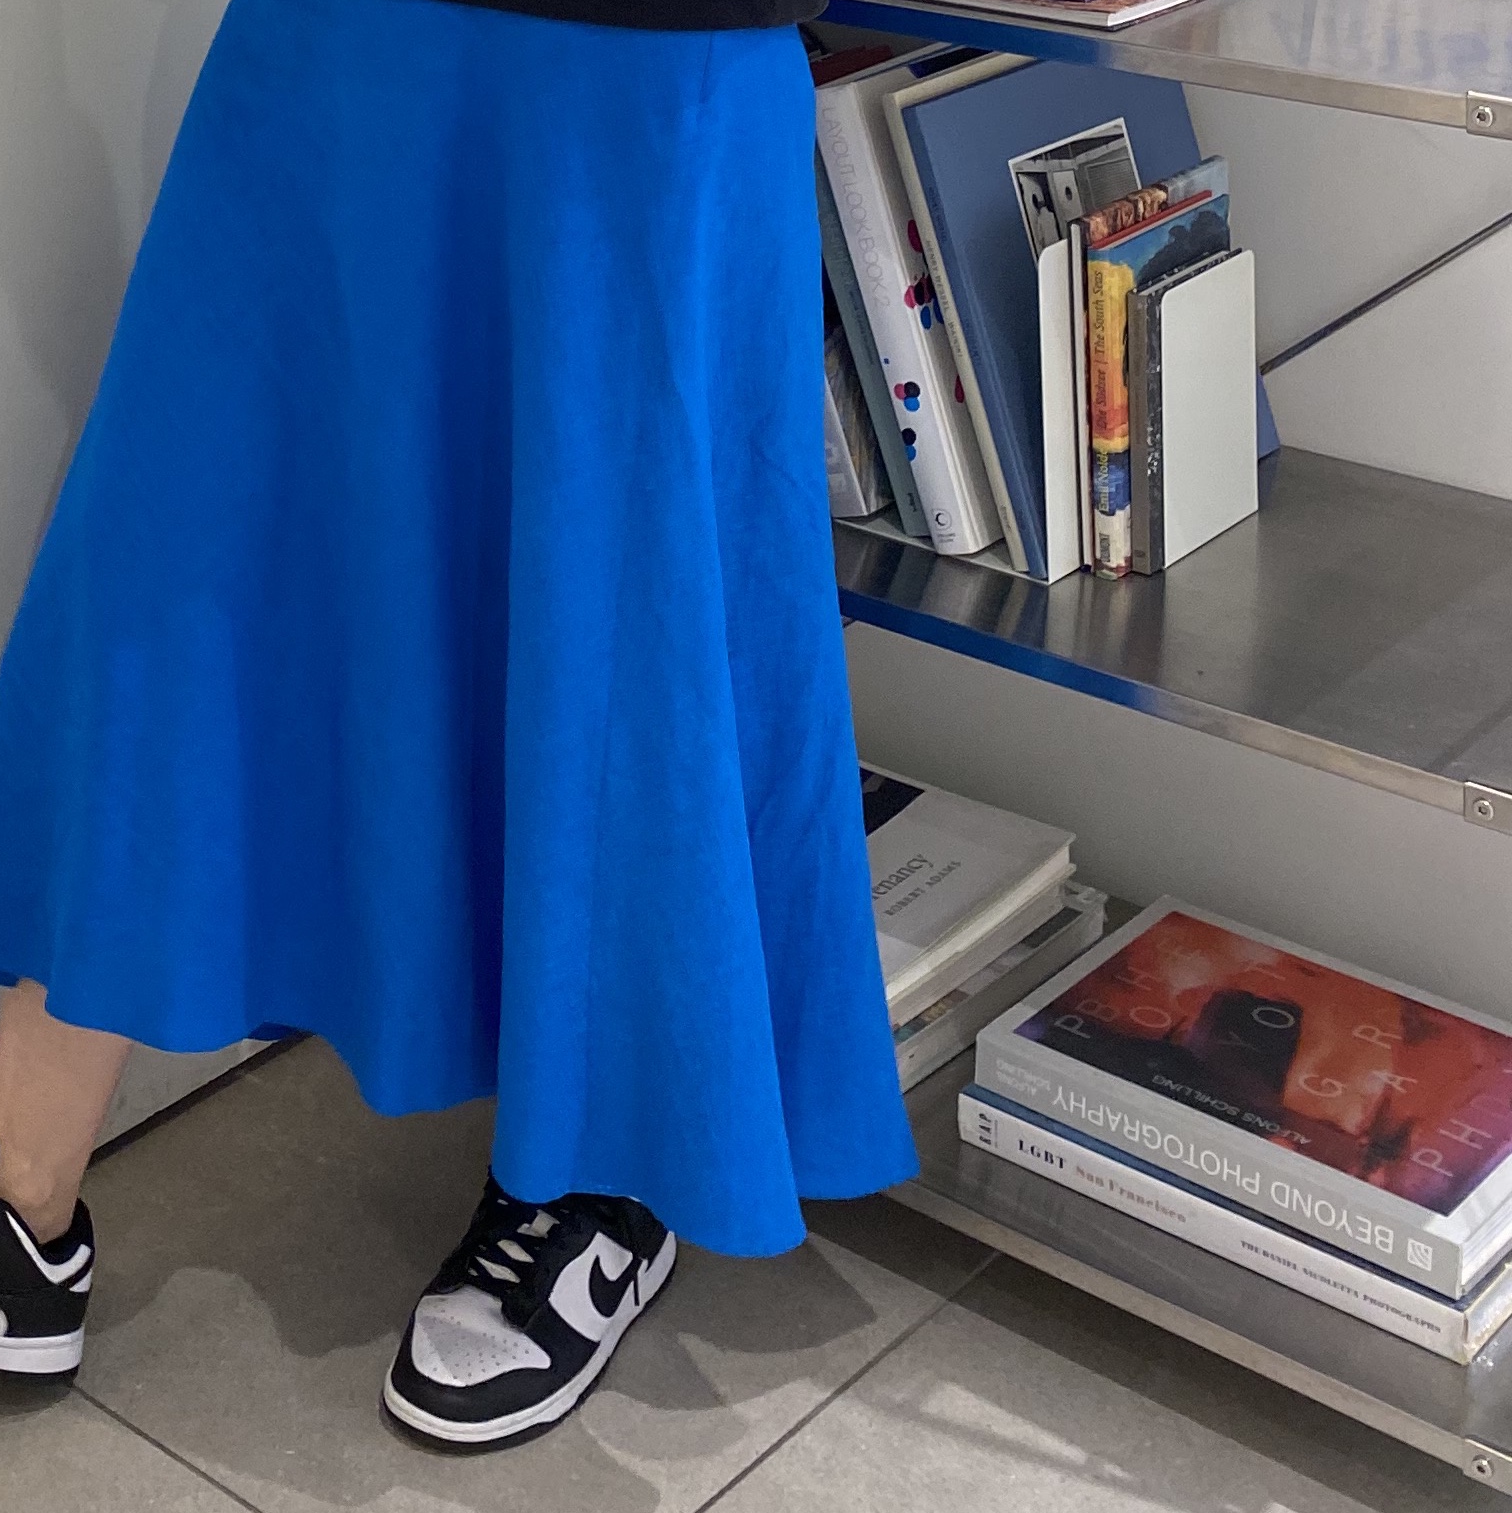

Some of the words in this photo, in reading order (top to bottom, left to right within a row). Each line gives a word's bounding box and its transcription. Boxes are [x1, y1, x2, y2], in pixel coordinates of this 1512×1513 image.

[820, 105, 856, 180] LAYOUT
[842, 180, 873, 235] LOOK
[858, 235, 888, 292] BOOK
[924, 240, 939, 271] HENRY
[1093, 271, 1104, 294] Seas
[1093, 299, 1105, 331] South
[1094, 334, 1105, 354] The
[1099, 486, 1109, 511] Emil
[884, 888, 926, 916] ROBERT
[925, 860, 961, 887] ADAMS
[1152, 1074, 1239, 1117] SCHILLING
[1018, 1140, 1067, 1169] LGBT
[1052, 1086, 1261, 1195] PHOTOGRAPHY
[1270, 1181, 1394, 1254] BEYOND
